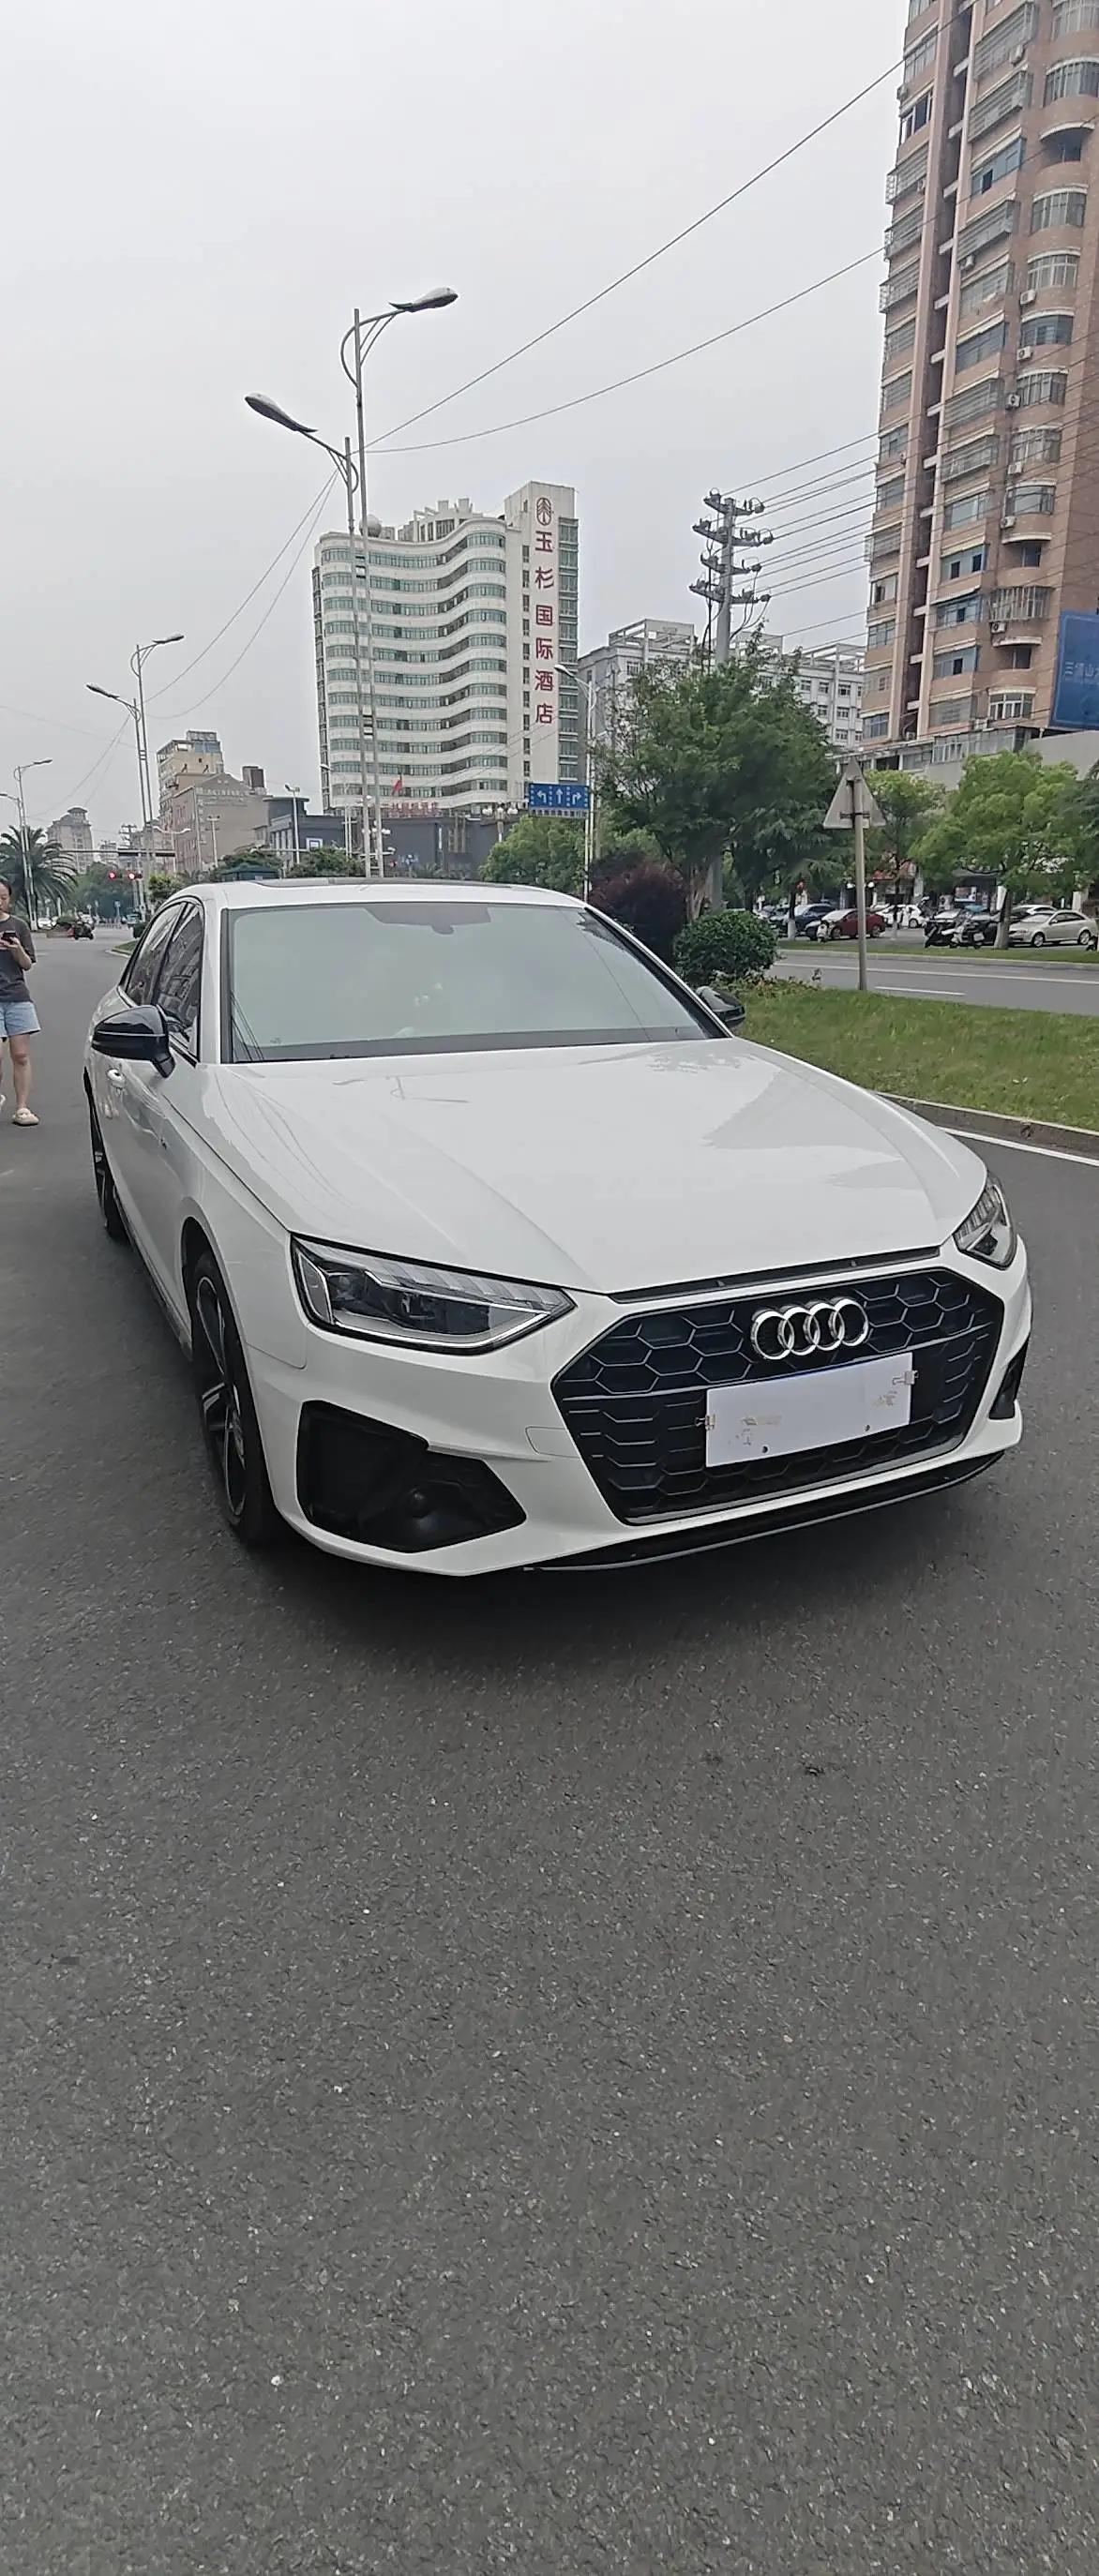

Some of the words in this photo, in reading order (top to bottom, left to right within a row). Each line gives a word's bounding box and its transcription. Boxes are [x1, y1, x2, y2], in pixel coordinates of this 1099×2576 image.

[534, 530, 555, 725] 玉杉国际酒店
